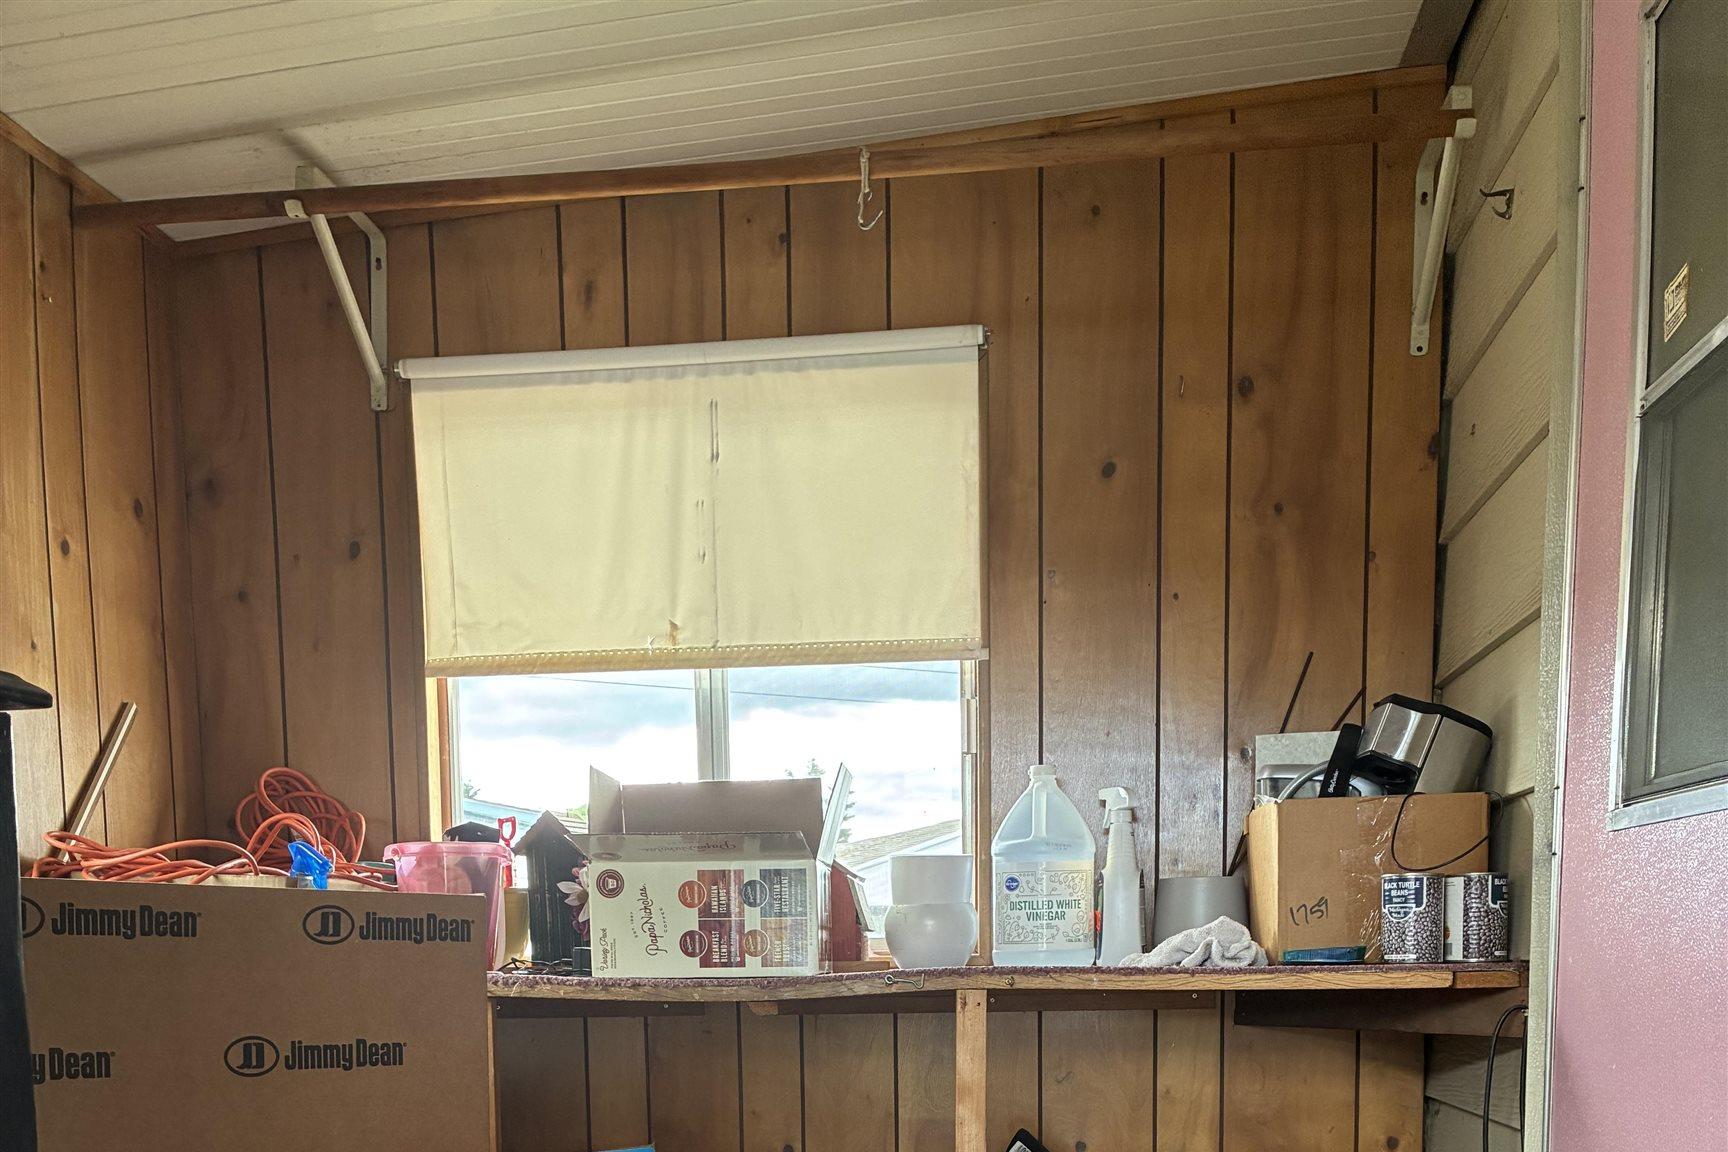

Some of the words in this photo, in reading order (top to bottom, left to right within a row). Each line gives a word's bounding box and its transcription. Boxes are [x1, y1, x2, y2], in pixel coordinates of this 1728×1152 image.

[1009, 899, 1054, 911] DISTILLED
[1056, 898, 1082, 910] WHITE
[1390, 889, 1408, 897] BEANS
[51, 902, 137, 940] Jimmy
[139, 904, 199, 938] Dean
[359, 911, 424, 945] Jimmy
[426, 913, 473, 943] Dean
[1025, 910, 1066, 922] VINEGAR
[48, 1047, 113, 1081] Dean
[284, 1040, 354, 1071] Jimmy
[356, 1038, 405, 1068] Dean
